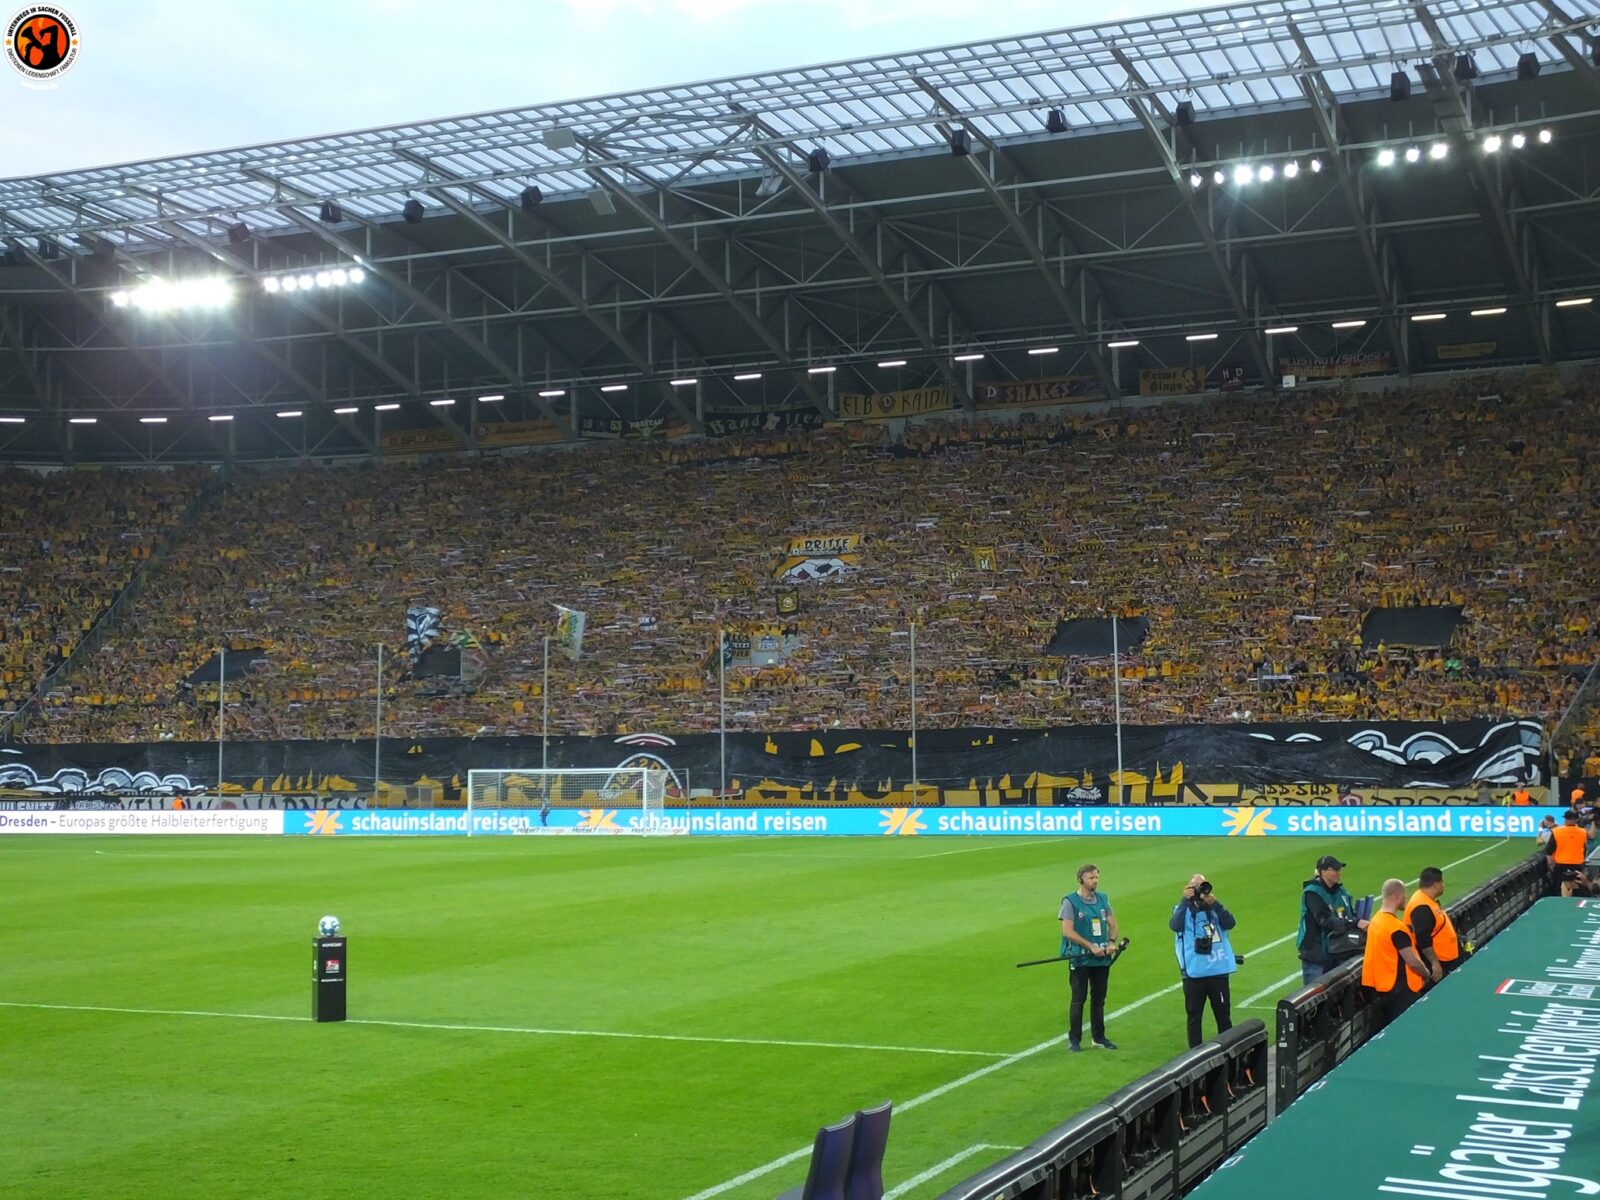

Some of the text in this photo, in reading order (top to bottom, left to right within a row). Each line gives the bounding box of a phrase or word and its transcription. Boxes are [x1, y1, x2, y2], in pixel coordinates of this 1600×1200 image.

[1006, 382, 1073, 402] SNAKES
[843, 395, 873, 415] ELB
[804, 537, 849, 550] DRITTE
[0, 814, 48, 828] Dresden
[59, 814, 106, 831] Europas
[108, 814, 148, 831] größte
[151, 813, 268, 831] Halbleiterfertigung
[352, 811, 531, 832] schauinsland reisen
[628, 811, 827, 832] schauinsland reisen
[938, 811, 1161, 832] schauinsland reisen
[1288, 811, 1534, 833] schauinsland reisen
[1456, 1002, 1600, 1110] Latschenkiefer
[1377, 1111, 1600, 1200] llgäuer
